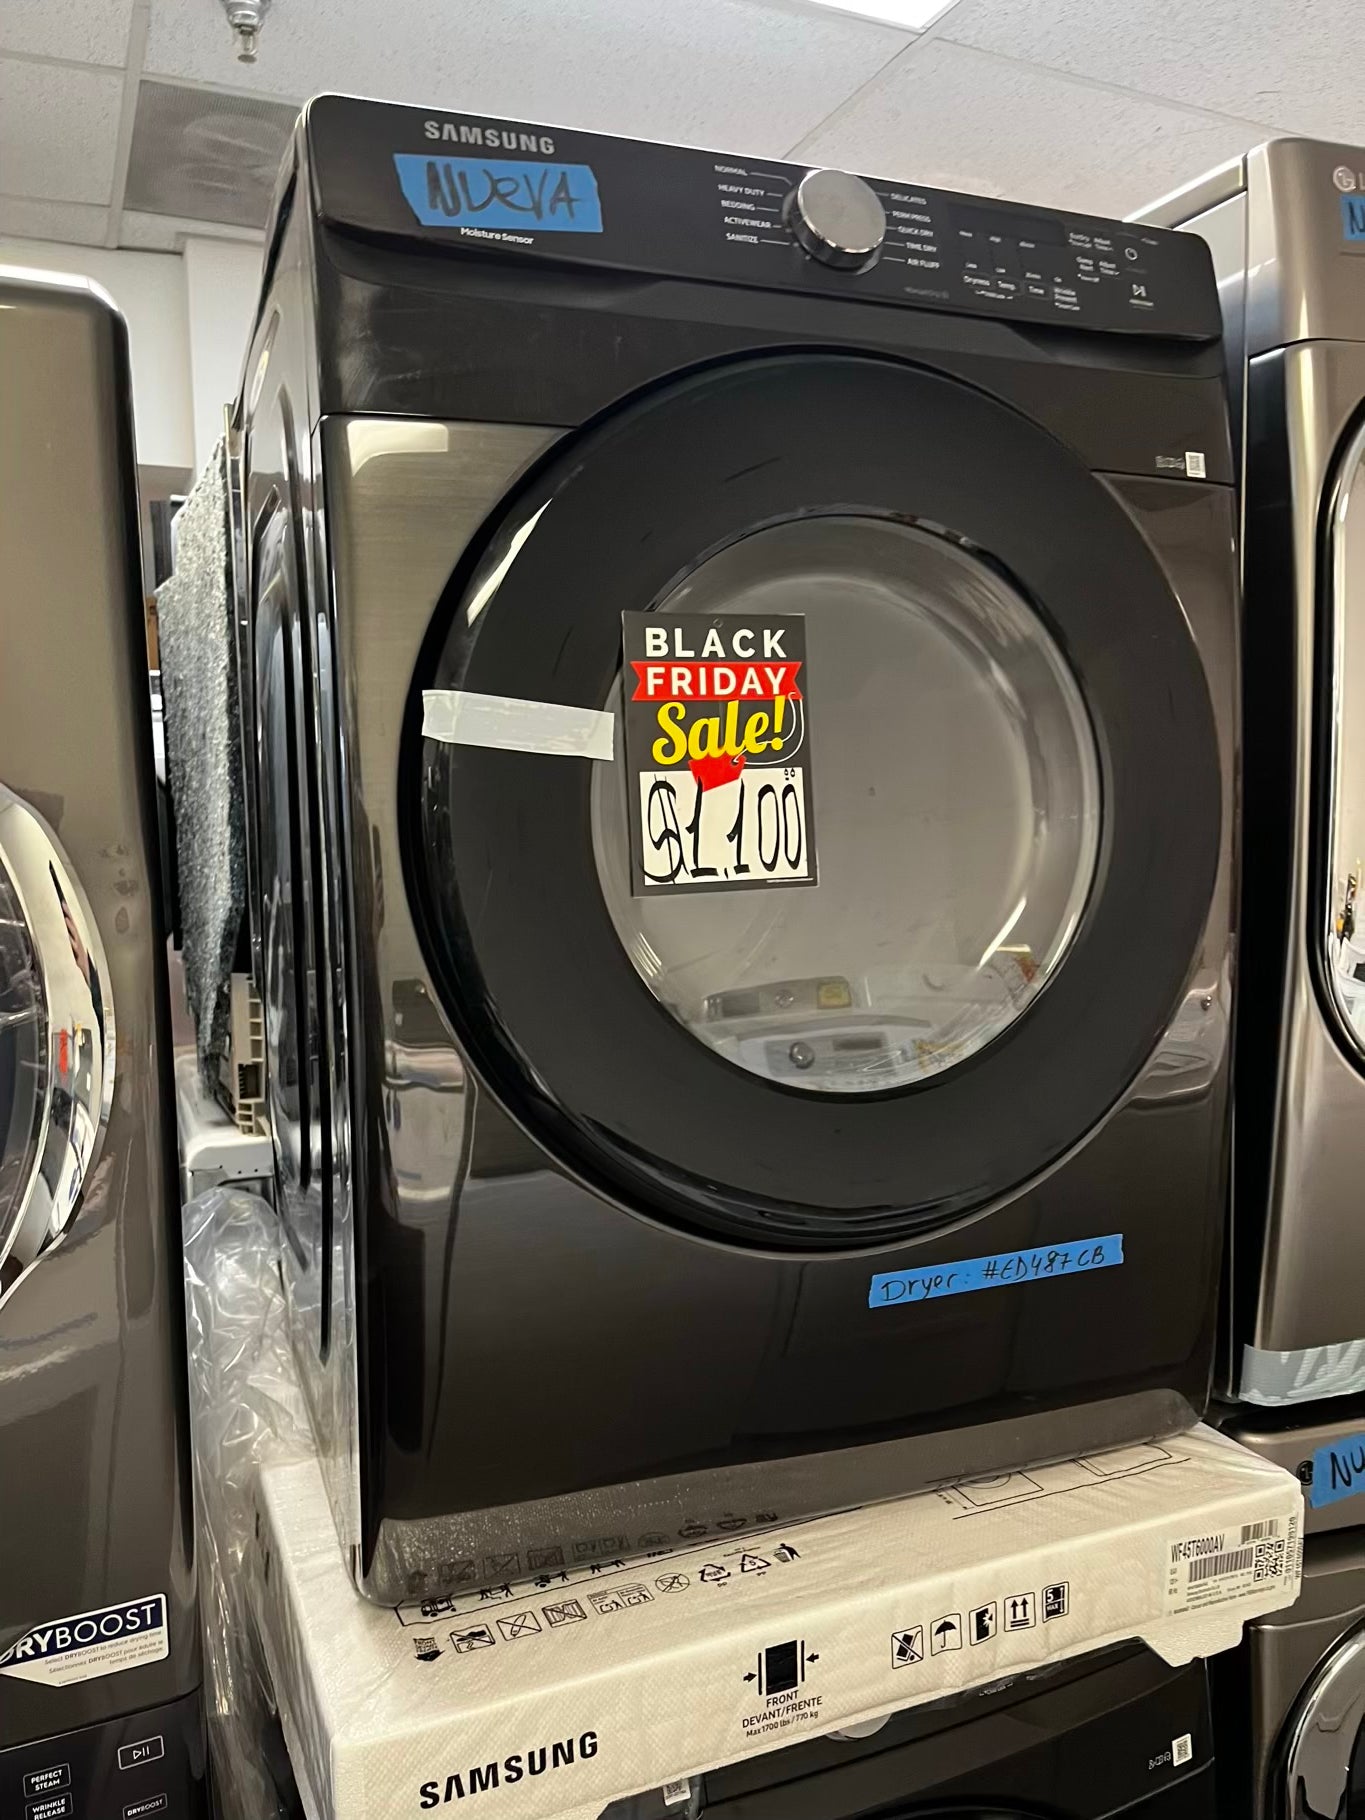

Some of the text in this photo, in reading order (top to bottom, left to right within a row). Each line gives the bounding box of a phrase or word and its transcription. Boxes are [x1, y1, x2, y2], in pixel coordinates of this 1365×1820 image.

[424, 120, 555, 155] SAMSUNG
[718, 184, 765, 197] HEAVY DUTY
[724, 216, 771, 229] ACTIVEWEAR
[460, 227, 535, 245] Moisture Sensor
[644, 627, 787, 658] BLACK
[646, 666, 788, 696] FRIDAY
[652, 695, 785, 766] Sale!
[1046, 1588, 1054, 1603] 5
[64, 1646, 99, 1661] DRYBOOST
[88, 1651, 122, 1664] DRYBOOST
[766, 1690, 799, 1708] FRONT
[742, 1695, 823, 1729] DEVANT/FRENTE
[779, 1718, 790, 1728] lbs
[809, 1710, 819, 1719] kg
[30, 1769, 63, 1785] PERFECT
[419, 1731, 598, 1809] SAMSUNG
[34, 1779, 61, 1792] STEAM
[32, 1798, 66, 1814] WRINKLE
[33, 1806, 66, 1820] RELEASE
[127, 1799, 164, 1817] DRYBOOST
